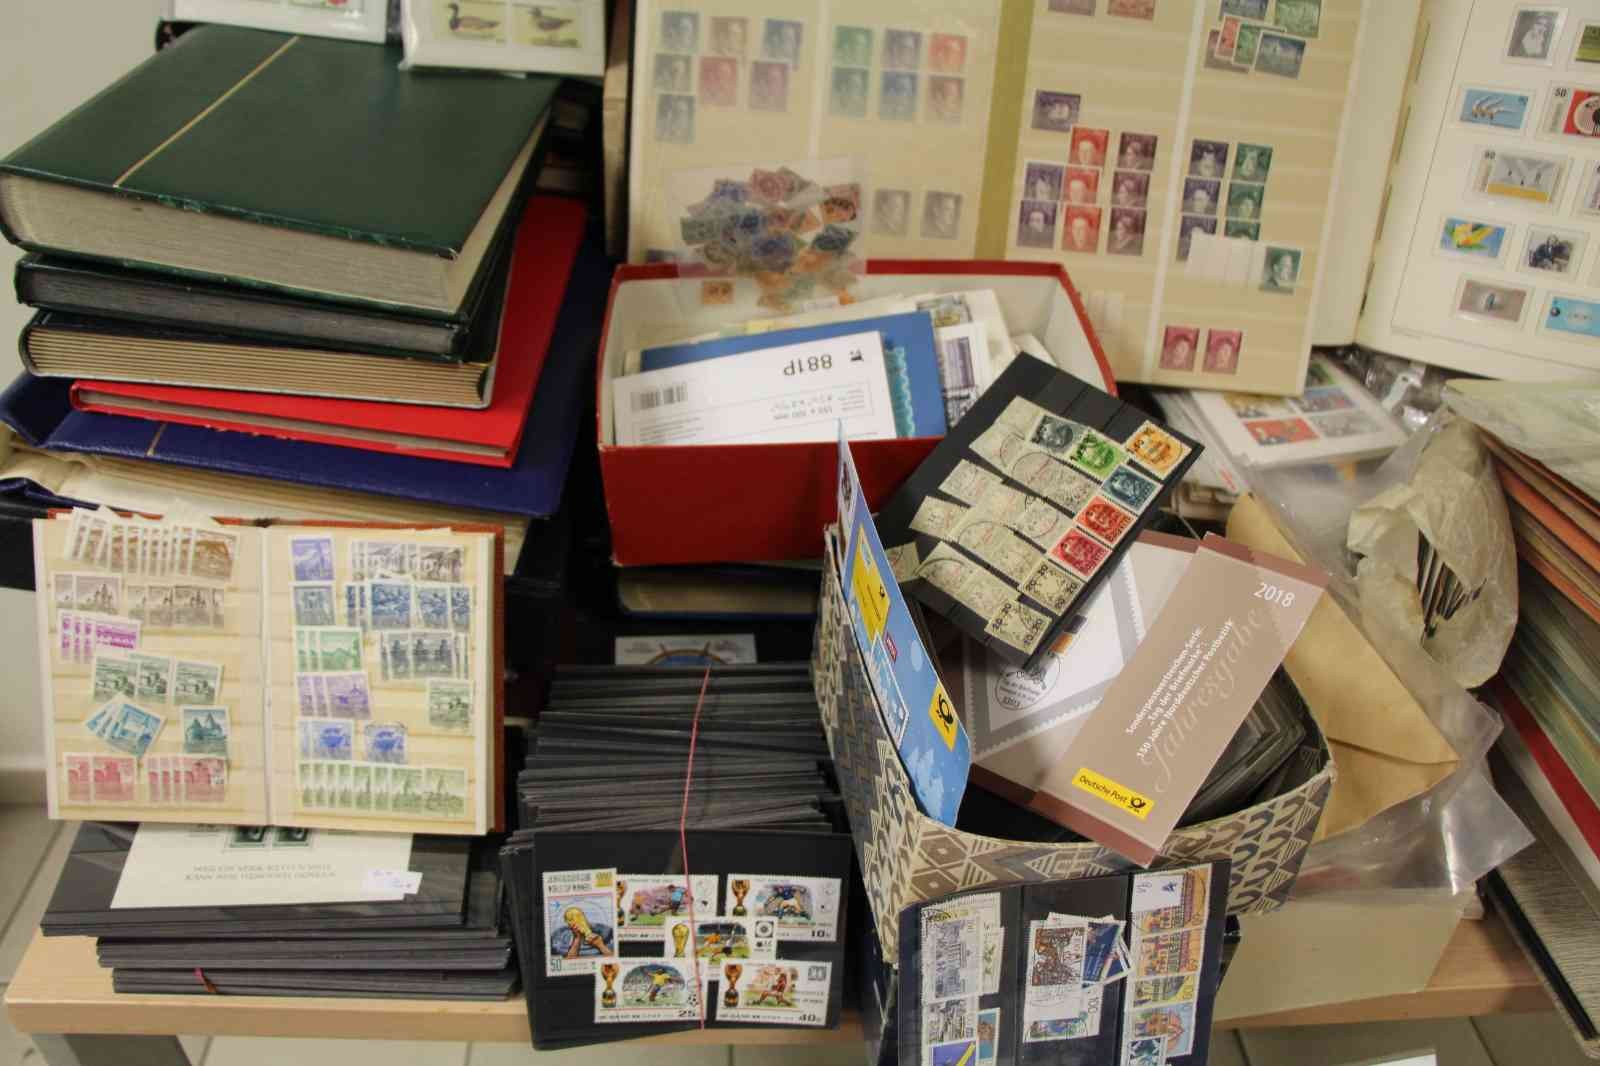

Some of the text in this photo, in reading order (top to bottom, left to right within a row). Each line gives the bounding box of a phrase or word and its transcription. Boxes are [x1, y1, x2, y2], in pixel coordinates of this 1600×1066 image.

[783, 354, 833, 376] 881P
[1254, 581, 1296, 608] 2018
[1158, 691, 1174, 708] der
[1136, 741, 1152, 759] 150
[1147, 718, 1168, 743] Jahre
[1110, 790, 1128, 803] Post
